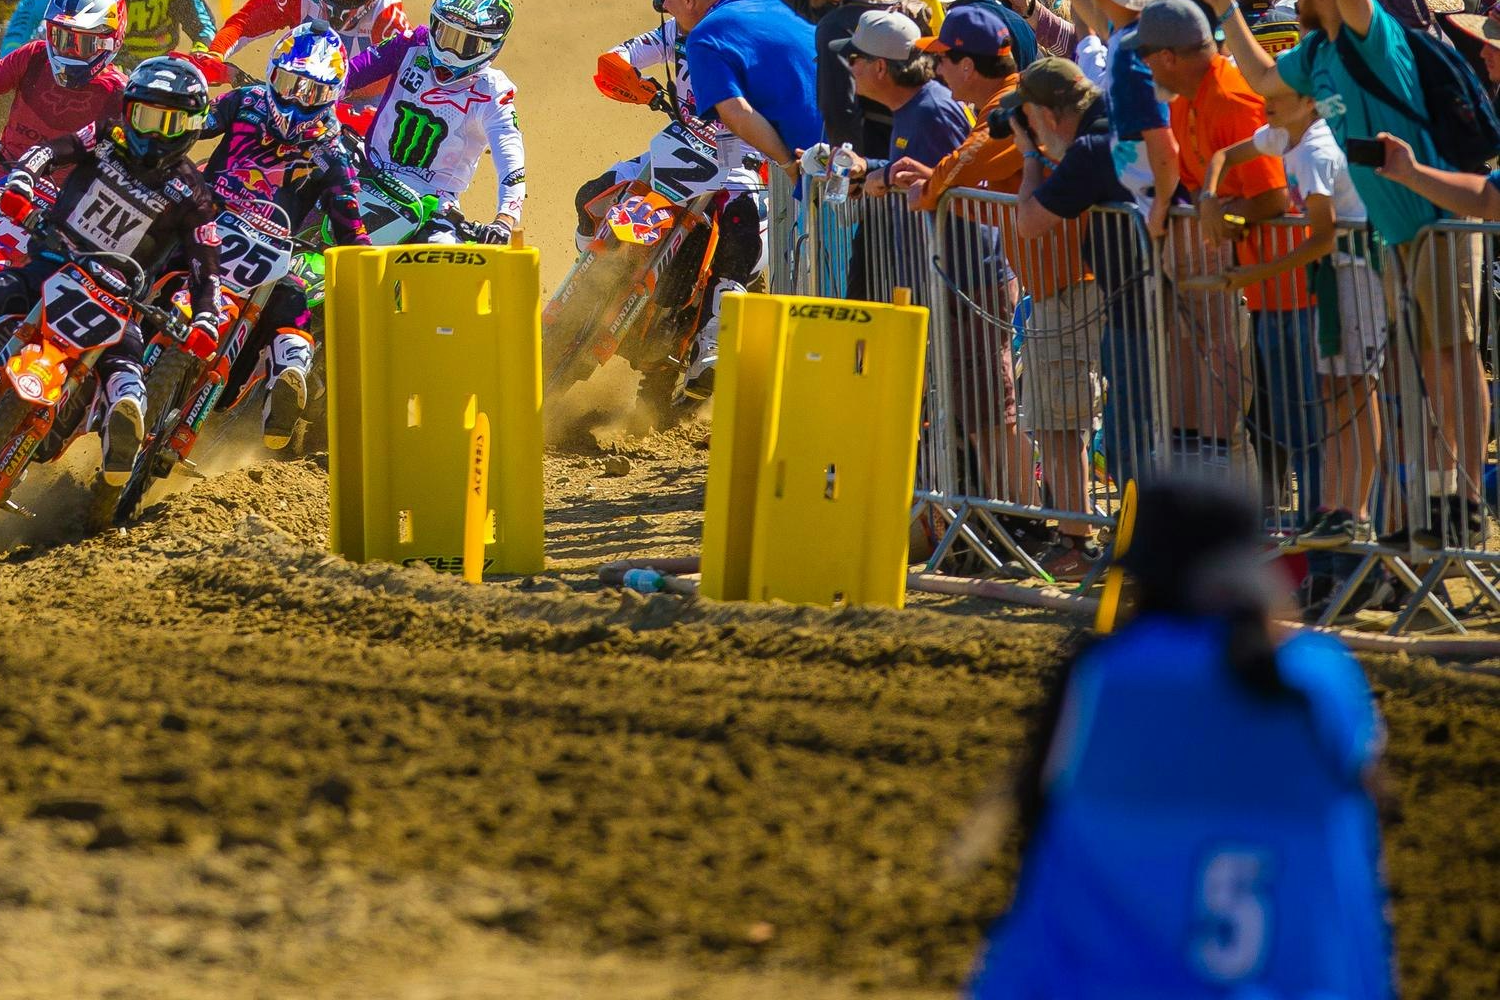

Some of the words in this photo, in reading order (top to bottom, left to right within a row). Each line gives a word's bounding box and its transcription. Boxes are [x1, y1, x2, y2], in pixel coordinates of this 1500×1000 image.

[370, 187, 391, 204] LUCAS
[654, 147, 720, 199] 2
[76, 218, 120, 250] RACING
[81, 192, 143, 243] FLY
[219, 234, 281, 287] 25
[45, 283, 124, 350] 19
[100, 293, 115, 308] OIL
[5, 434, 37, 477] GALFER
[1199, 846, 1268, 983] 5
